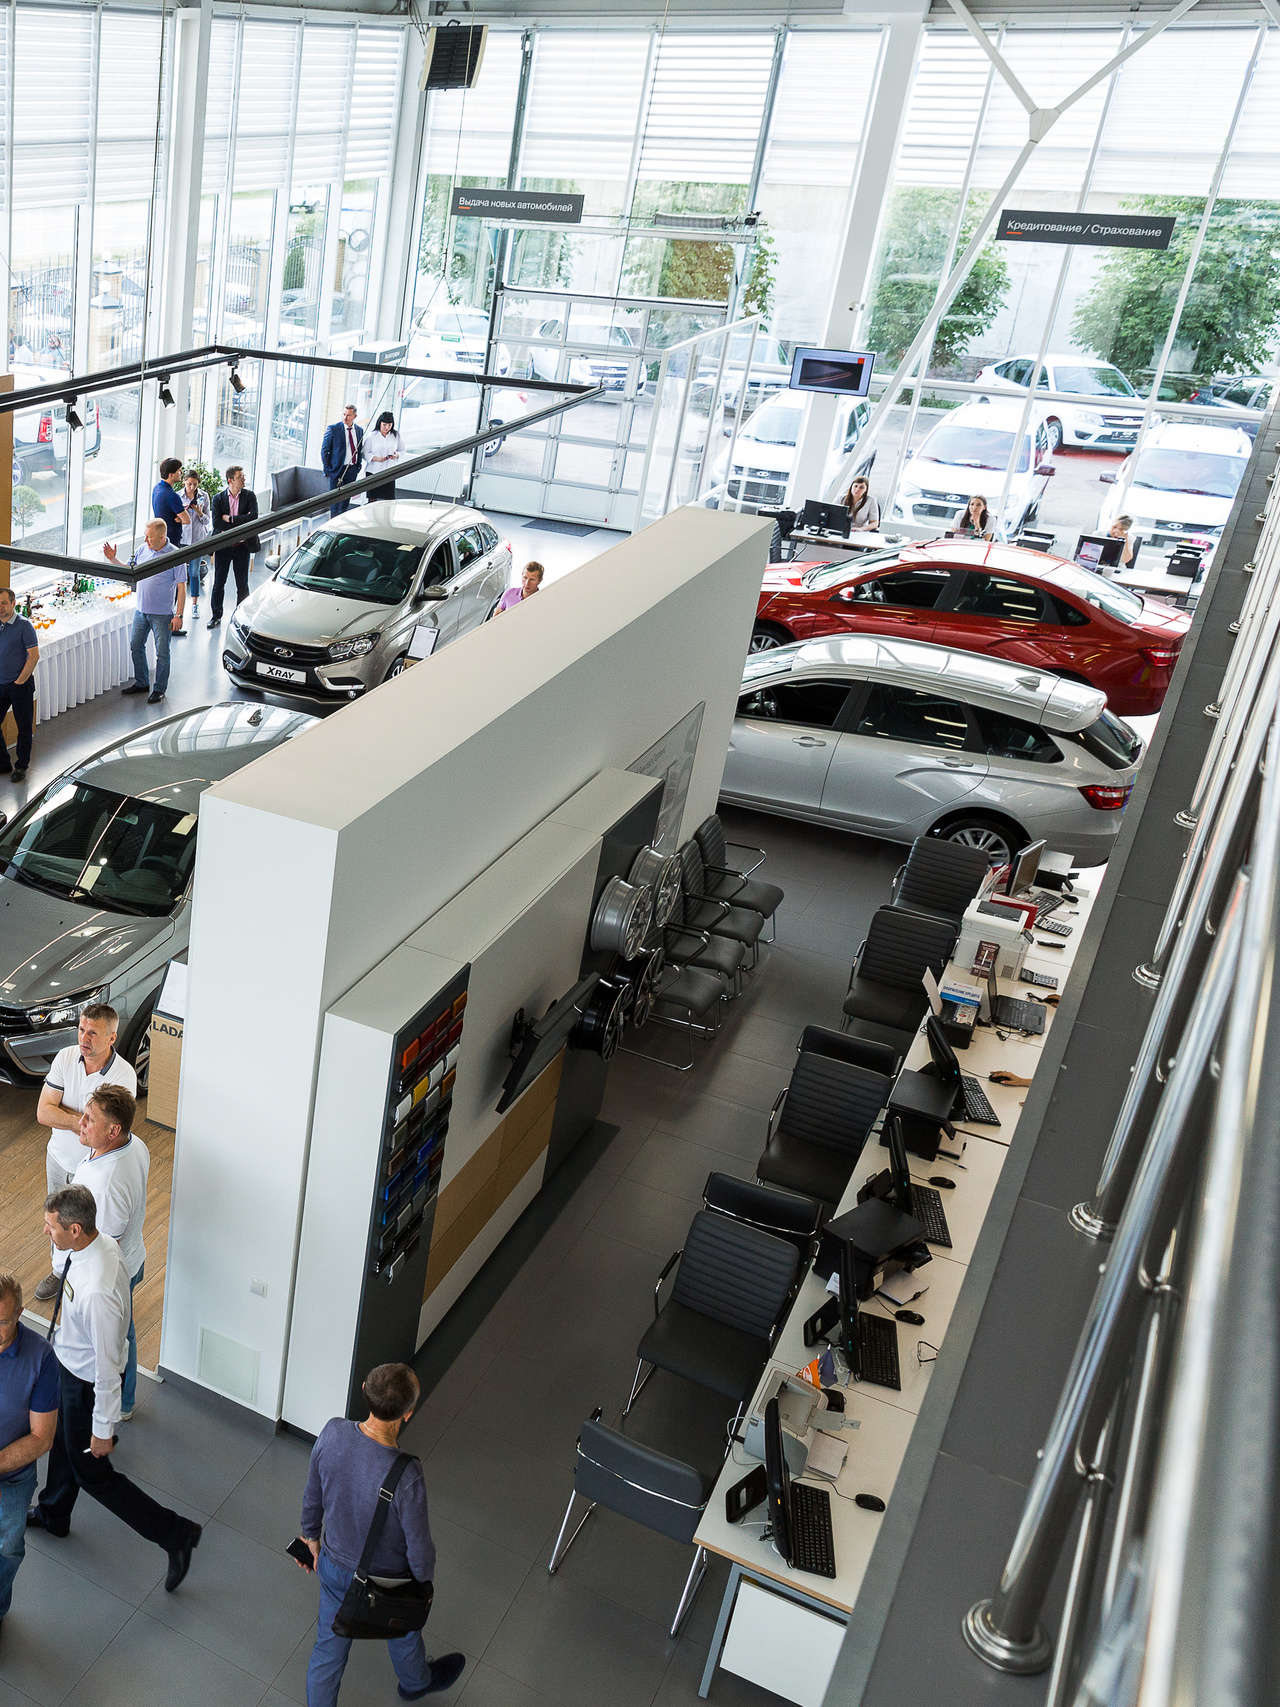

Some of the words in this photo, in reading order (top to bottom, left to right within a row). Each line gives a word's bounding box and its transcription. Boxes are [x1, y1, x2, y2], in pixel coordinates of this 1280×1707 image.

[458, 197, 489, 207] Выдача
[490, 200, 516, 208] новых
[516, 202, 573, 212] автомобилей
[1007, 220, 1082, 233] Кредитование
[1090, 224, 1162, 237] Страхование
[266, 666, 295, 679] XRAY
